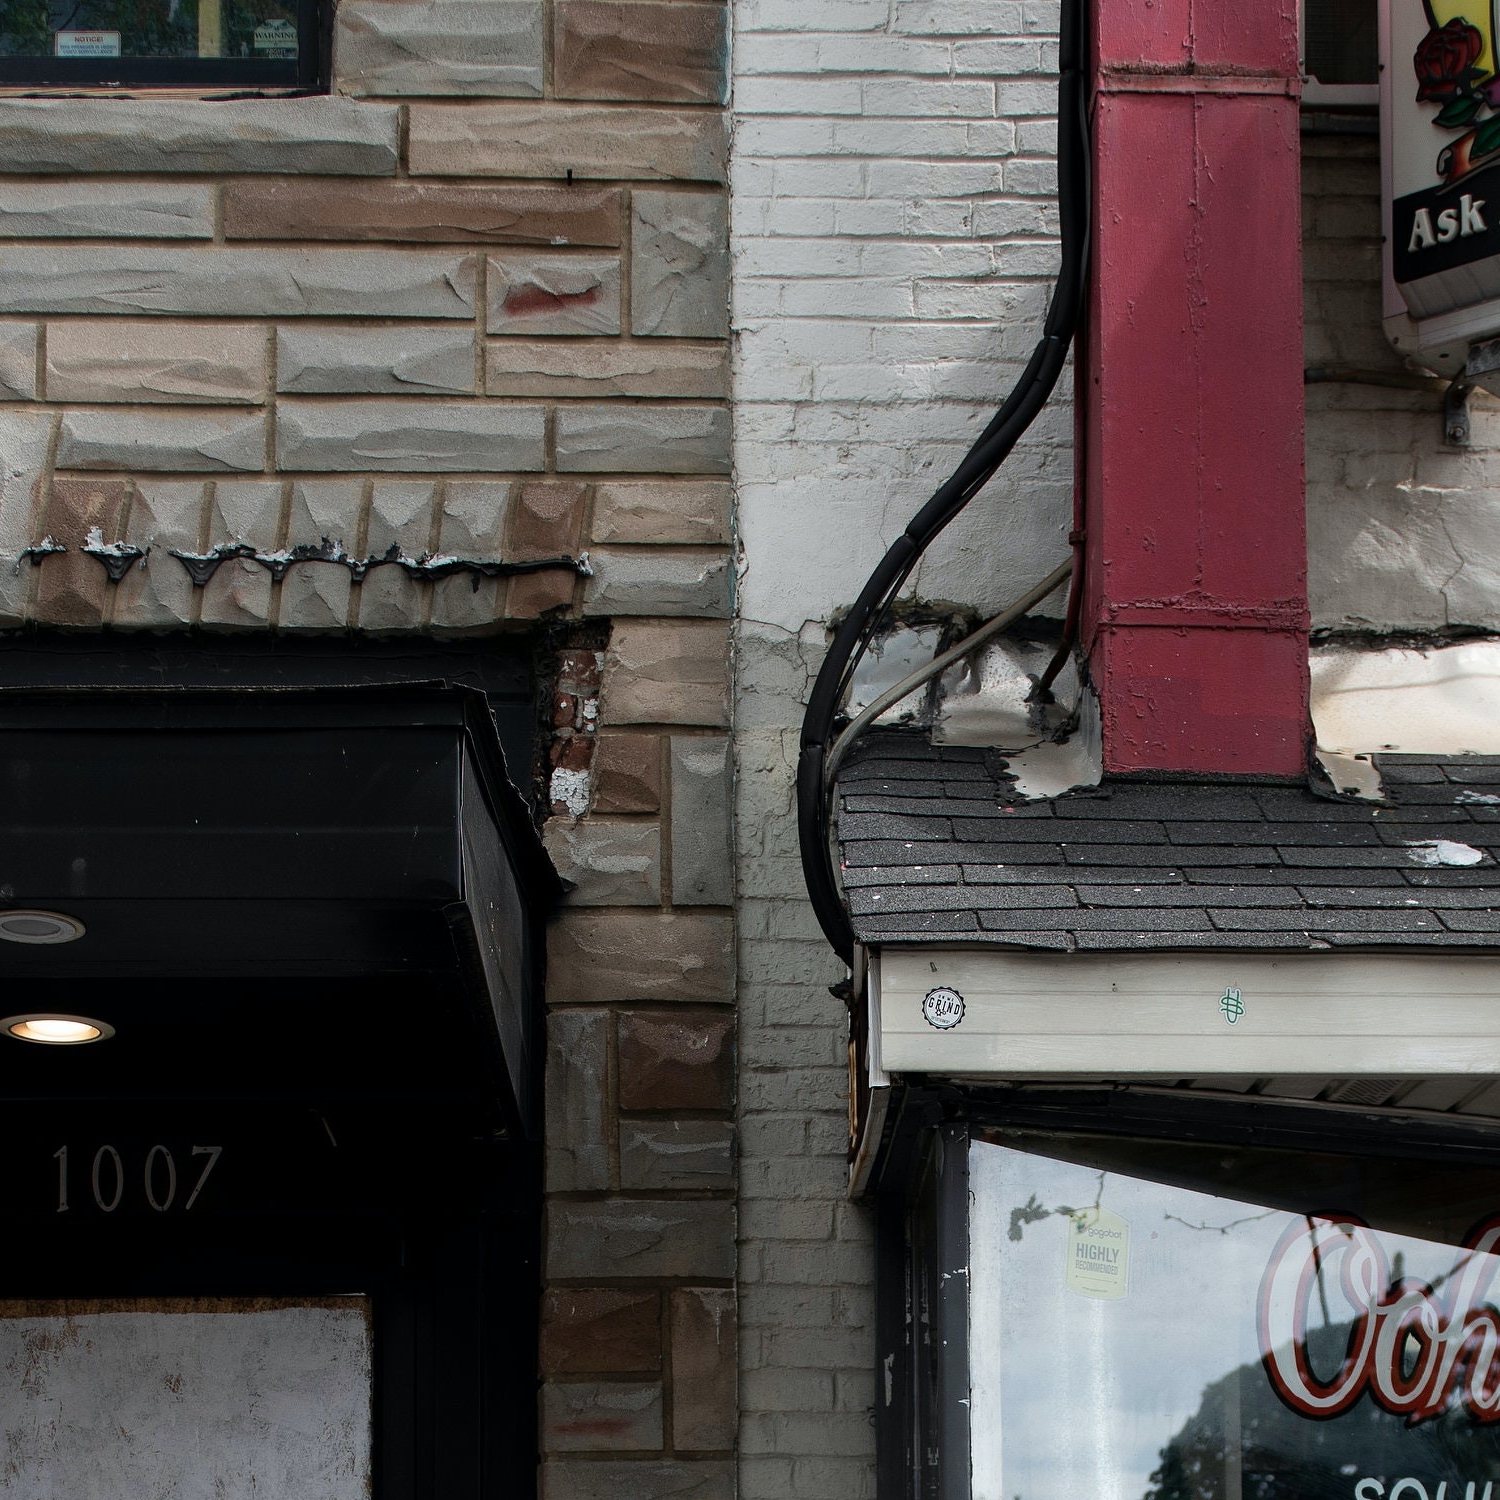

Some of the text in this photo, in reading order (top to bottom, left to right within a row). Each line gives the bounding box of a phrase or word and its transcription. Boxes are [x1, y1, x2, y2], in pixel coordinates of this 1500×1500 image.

[1408, 194, 1487, 252] Ask
[928, 997, 961, 1015] GRIND
[53, 1145, 223, 1212] 1007
[1076, 1242, 1120, 1263] HIGHLY
[1075, 1259, 1119, 1276] RECOMMENDED
